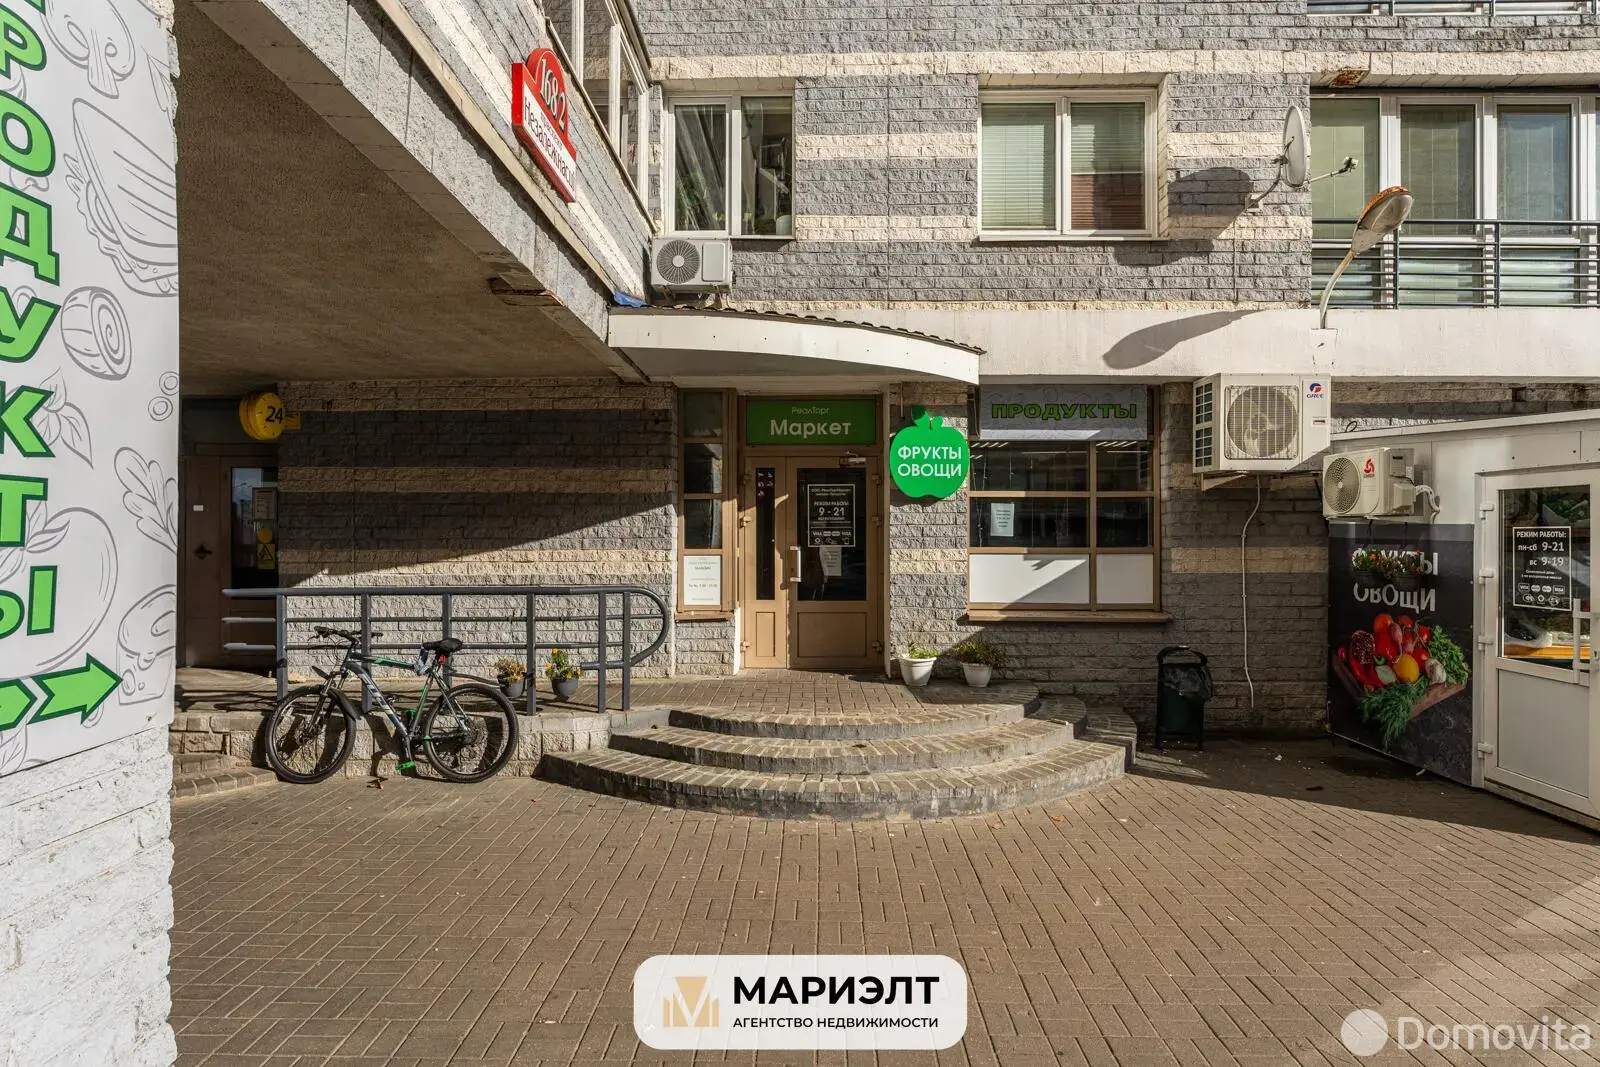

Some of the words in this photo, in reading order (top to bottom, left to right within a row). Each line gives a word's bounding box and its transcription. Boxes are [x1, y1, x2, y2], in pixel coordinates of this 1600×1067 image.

[540, 58, 566, 134] 1682
[0, 0, 61, 636] РОДУКТЫ
[265, 406, 284, 424] 24
[991, 403, 1138, 421] ПРОДУКТЫ
[770, 419, 852, 438] Маркет
[897, 445, 962, 460] ФРУКТЫ
[897, 463, 962, 479] ОВОЩИ
[833, 507, 845, 516] 21
[1518, 543, 1538, 551] пн-сб
[1541, 541, 1565, 552] 9-21
[1541, 556, 1564, 567] 9-19
